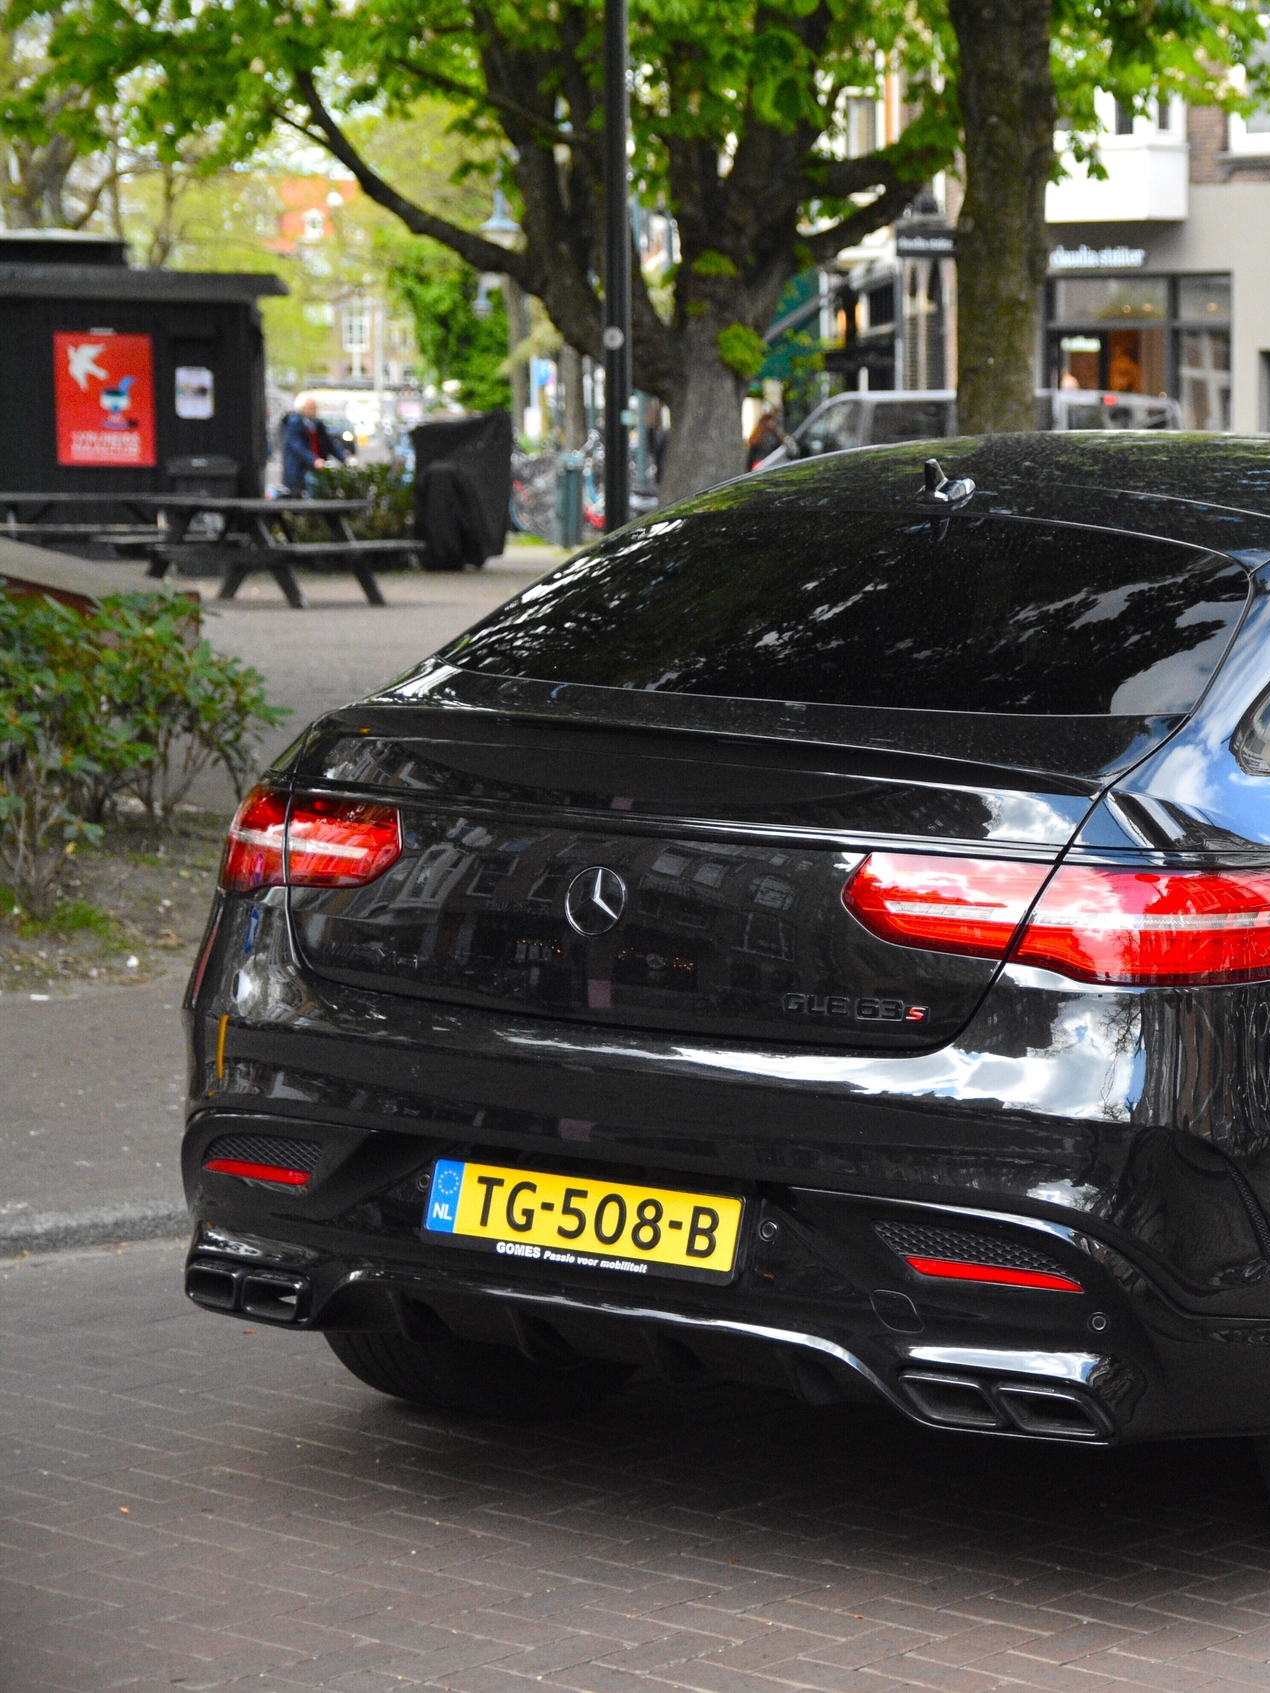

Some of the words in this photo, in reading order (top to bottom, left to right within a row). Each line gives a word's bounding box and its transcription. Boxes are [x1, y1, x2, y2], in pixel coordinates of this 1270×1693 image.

[783, 992, 849, 1016] GLE
[432, 1202, 452, 1221] NL
[477, 1175, 720, 1258] TG-508-B
[496, 1241, 541, 1259] GOMES
[543, 1250, 575, 1265] Passie
[577, 1256, 599, 1267] voor
[600, 1258, 647, 1274] mobiliteit
